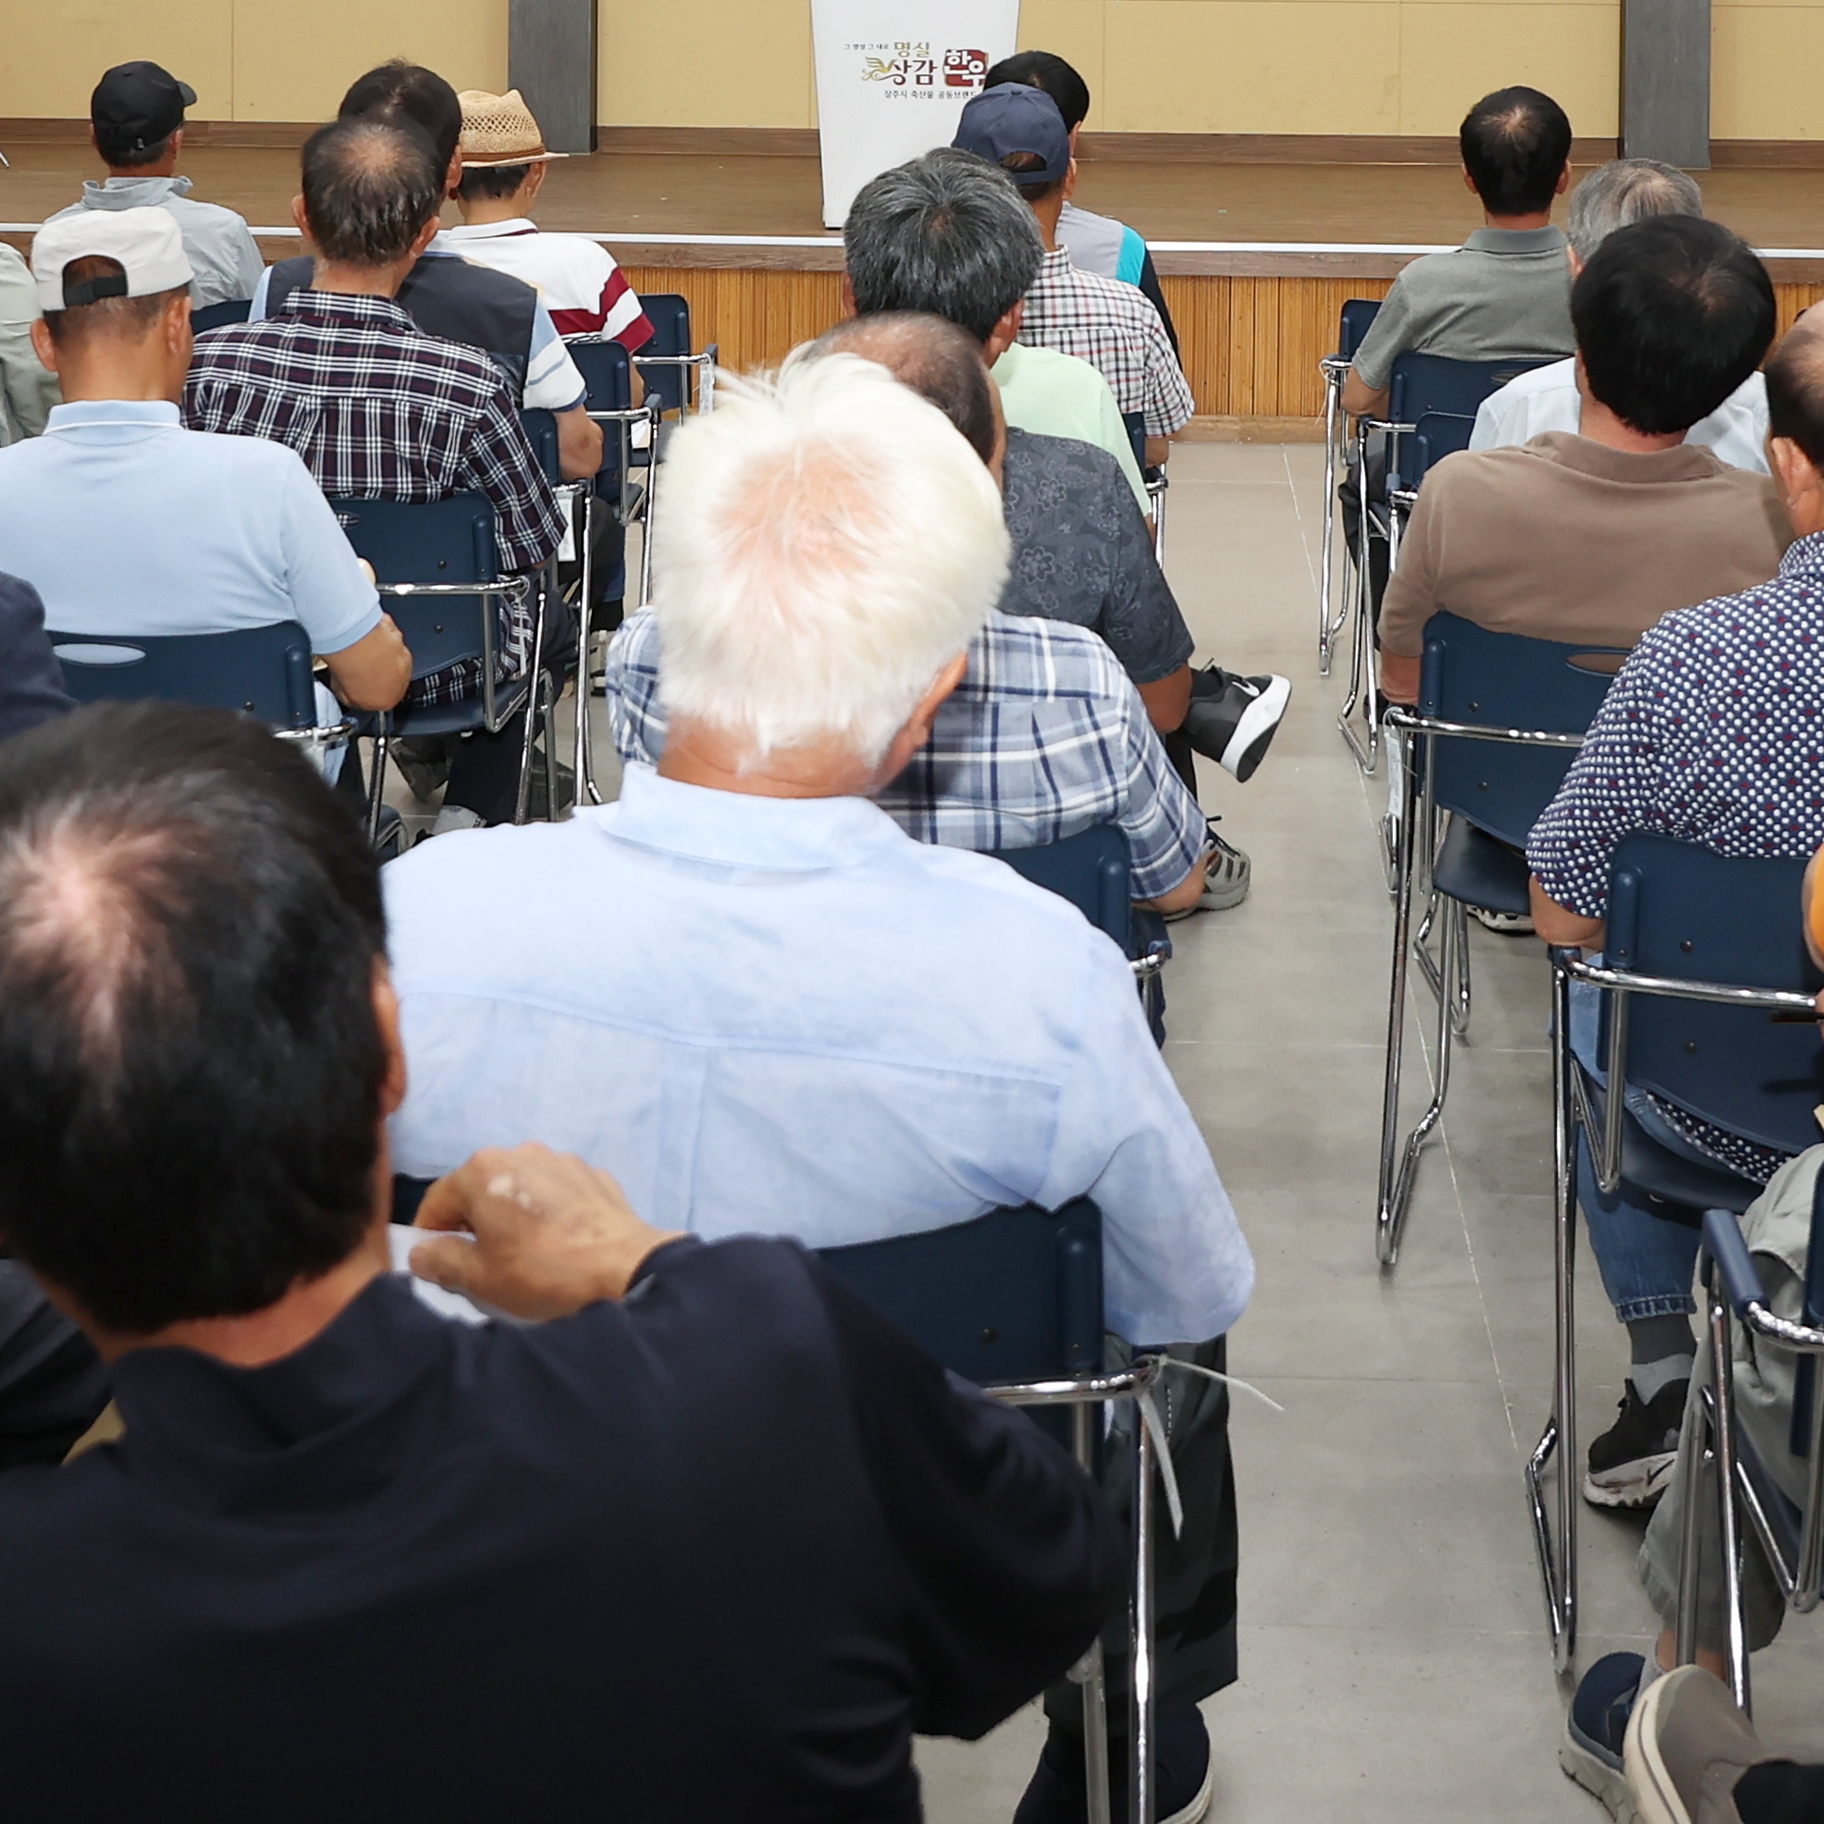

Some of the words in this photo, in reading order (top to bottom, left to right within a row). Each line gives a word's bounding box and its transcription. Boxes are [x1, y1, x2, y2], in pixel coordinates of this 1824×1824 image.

[893, 41, 930, 58] 명실
[892, 59, 939, 86] 상감
[883, 90, 908, 99] 상주시
